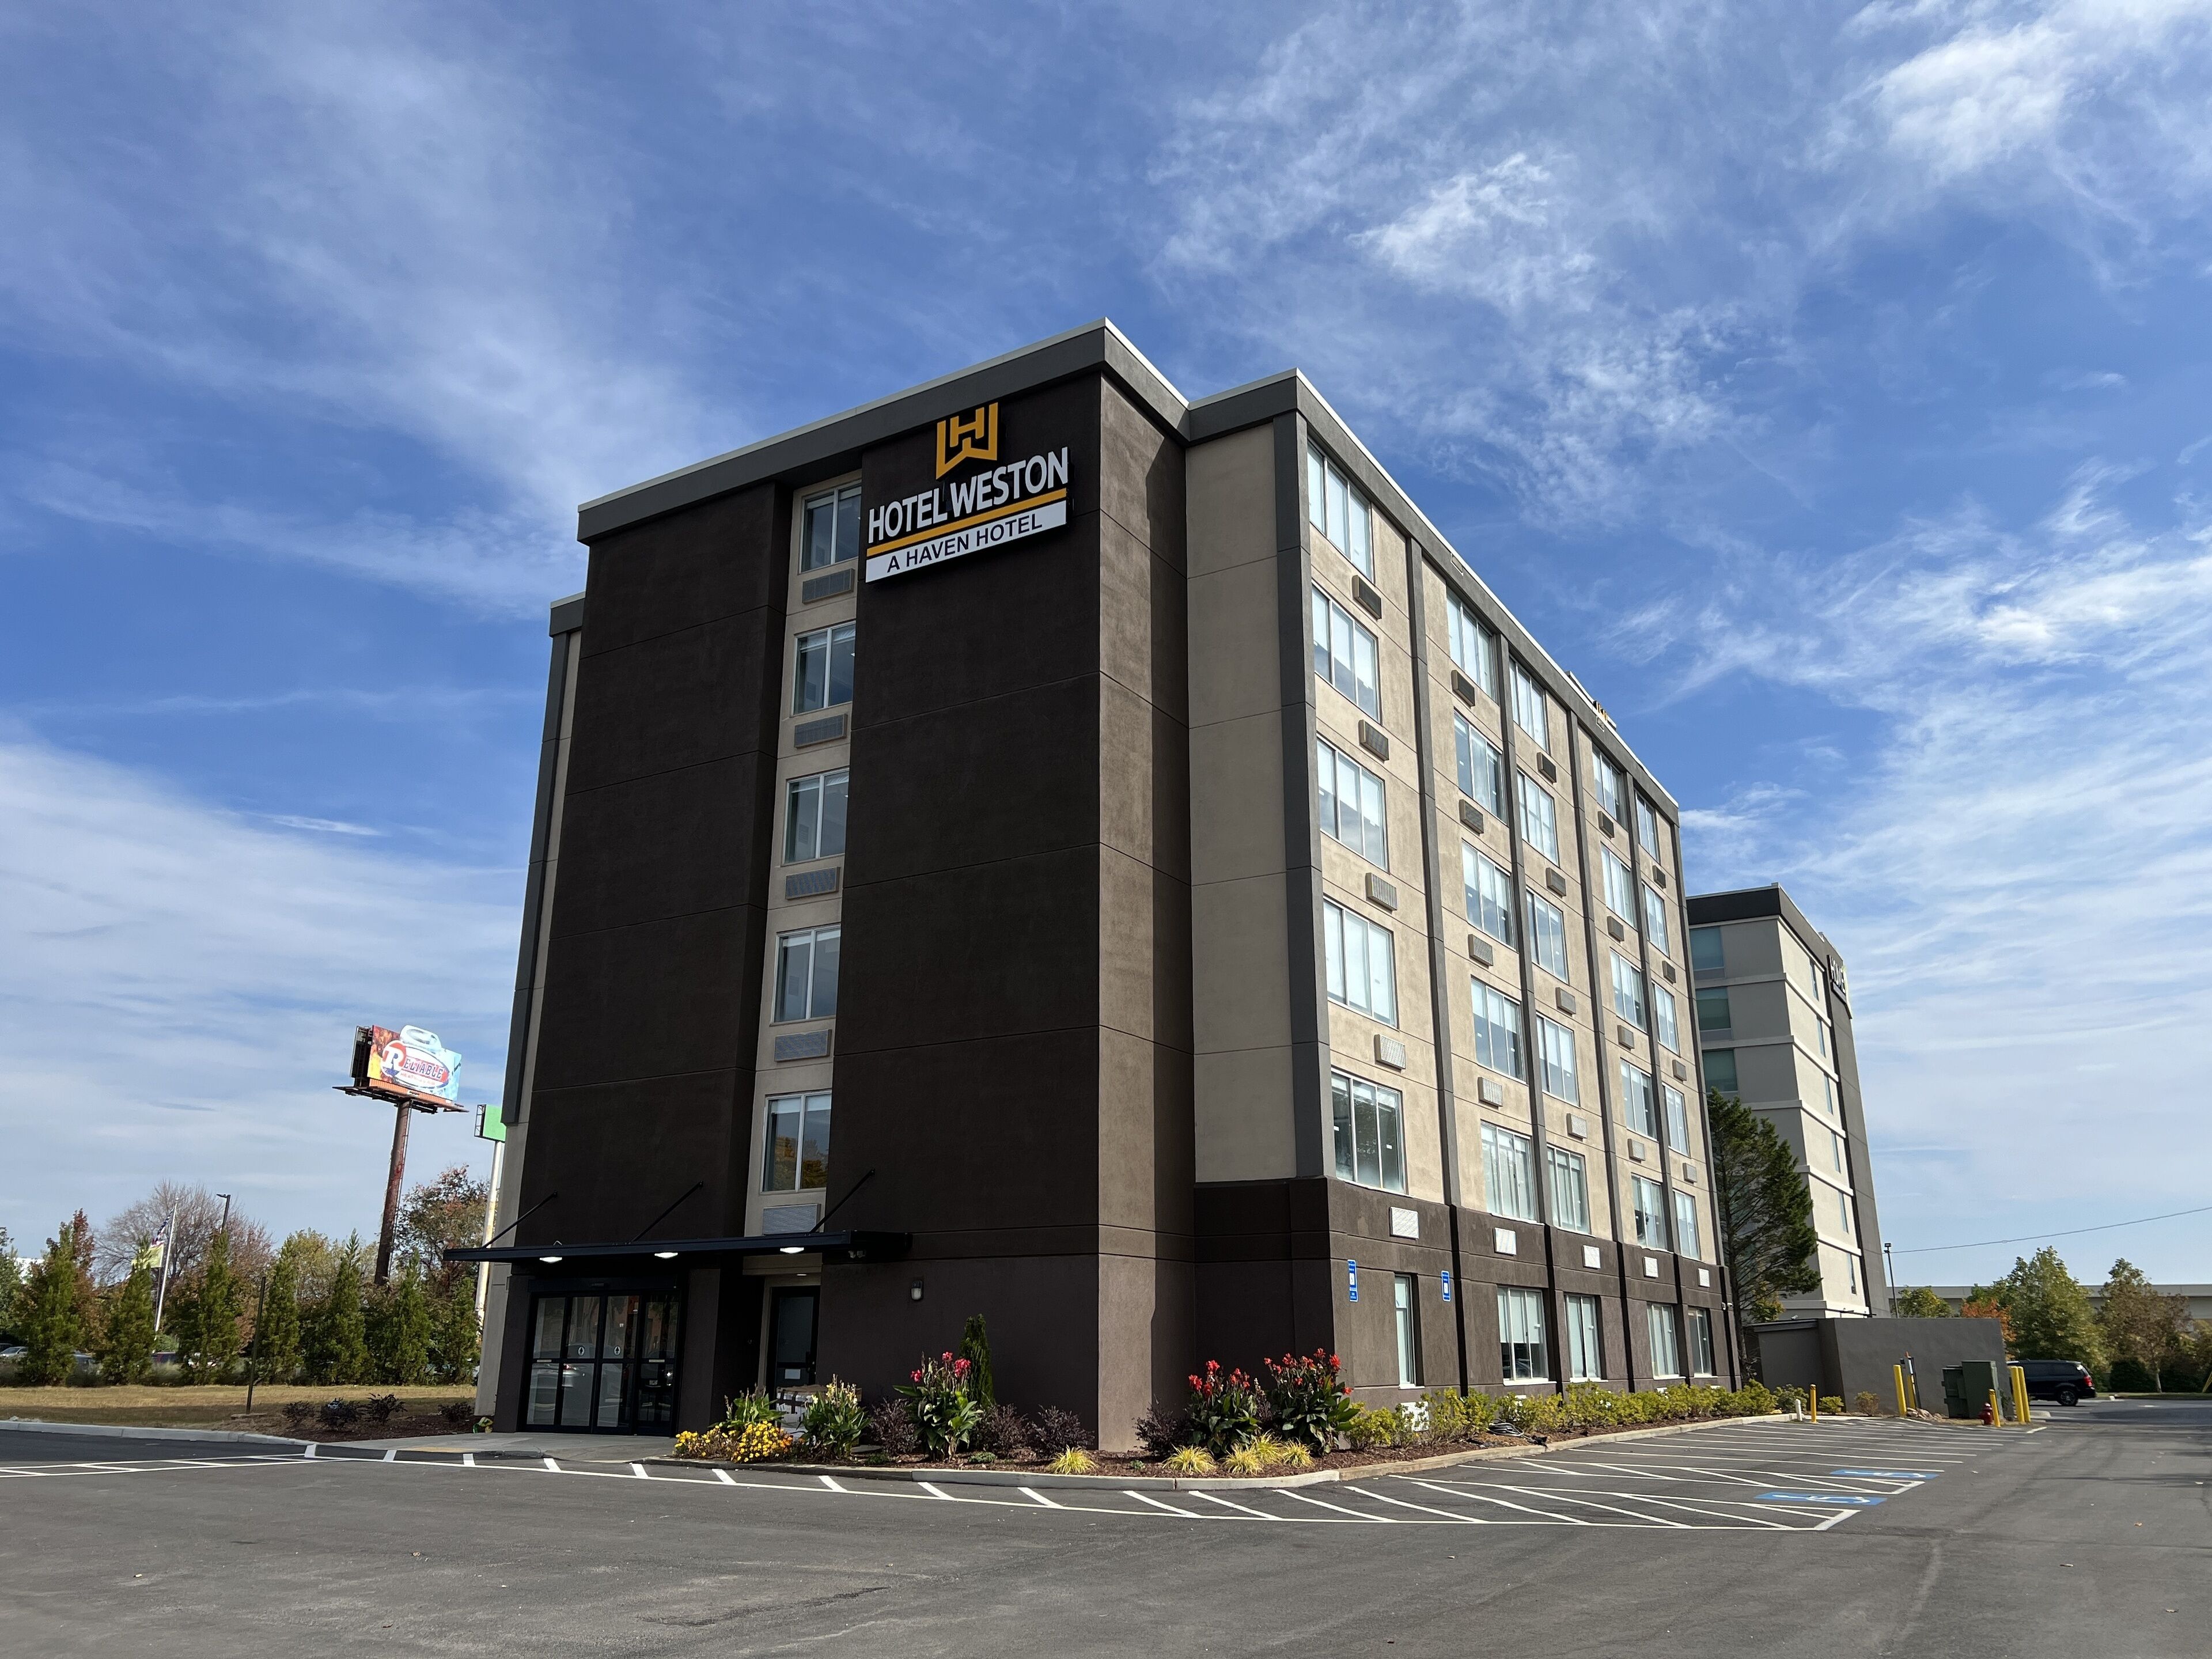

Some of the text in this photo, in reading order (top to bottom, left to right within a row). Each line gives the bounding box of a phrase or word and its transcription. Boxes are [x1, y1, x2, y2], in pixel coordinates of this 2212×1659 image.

[869, 446, 1069, 544] HOTEL WESTON
[887, 513, 1043, 573] A HAVEN HOTEL
[382, 1047, 444, 1079] RELIABLE
